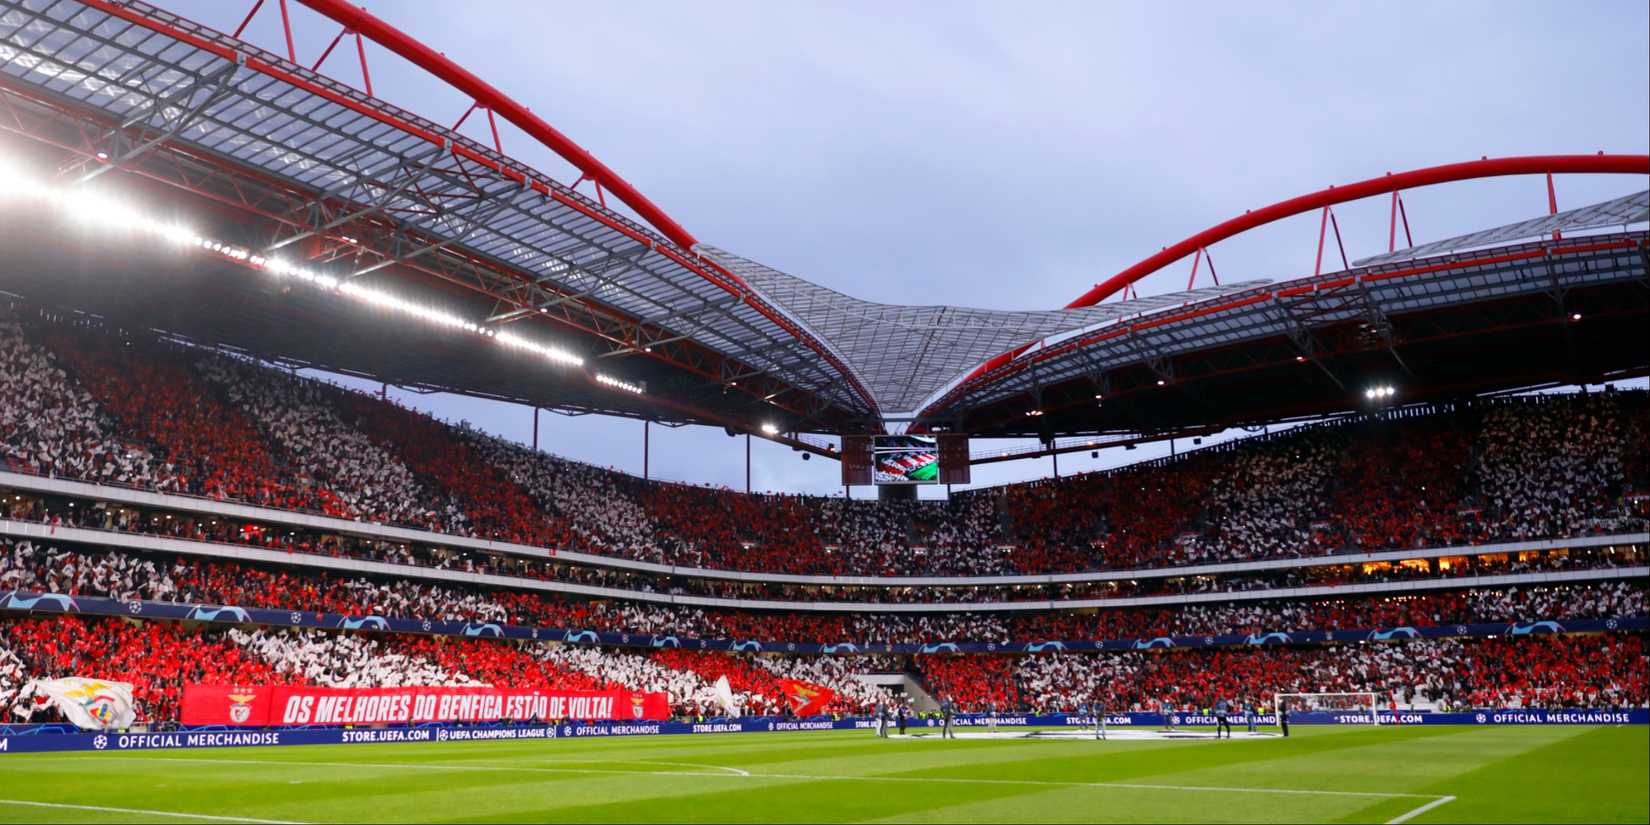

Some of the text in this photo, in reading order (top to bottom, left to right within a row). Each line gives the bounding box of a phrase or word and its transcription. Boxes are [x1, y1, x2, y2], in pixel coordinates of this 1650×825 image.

[283, 691, 614, 723] OS MELHORES DO BENFICA ESTÃO DE VOLTA!
[1185, 716, 1218, 724] OFFICIA
[1494, 713, 1630, 722] OFFICIAL MERCHANDISE
[576, 725, 660, 735] OFFICIAL MERCHANDISE
[693, 723, 742, 732] STORE.UEFA.COM
[342, 730, 430, 742] STORE.UEFA.COM
[449, 728, 545, 739] UEFA CHAMPIONS LEAGUE
[118, 732, 280, 748] OFFICIAL MERCHANDISE
